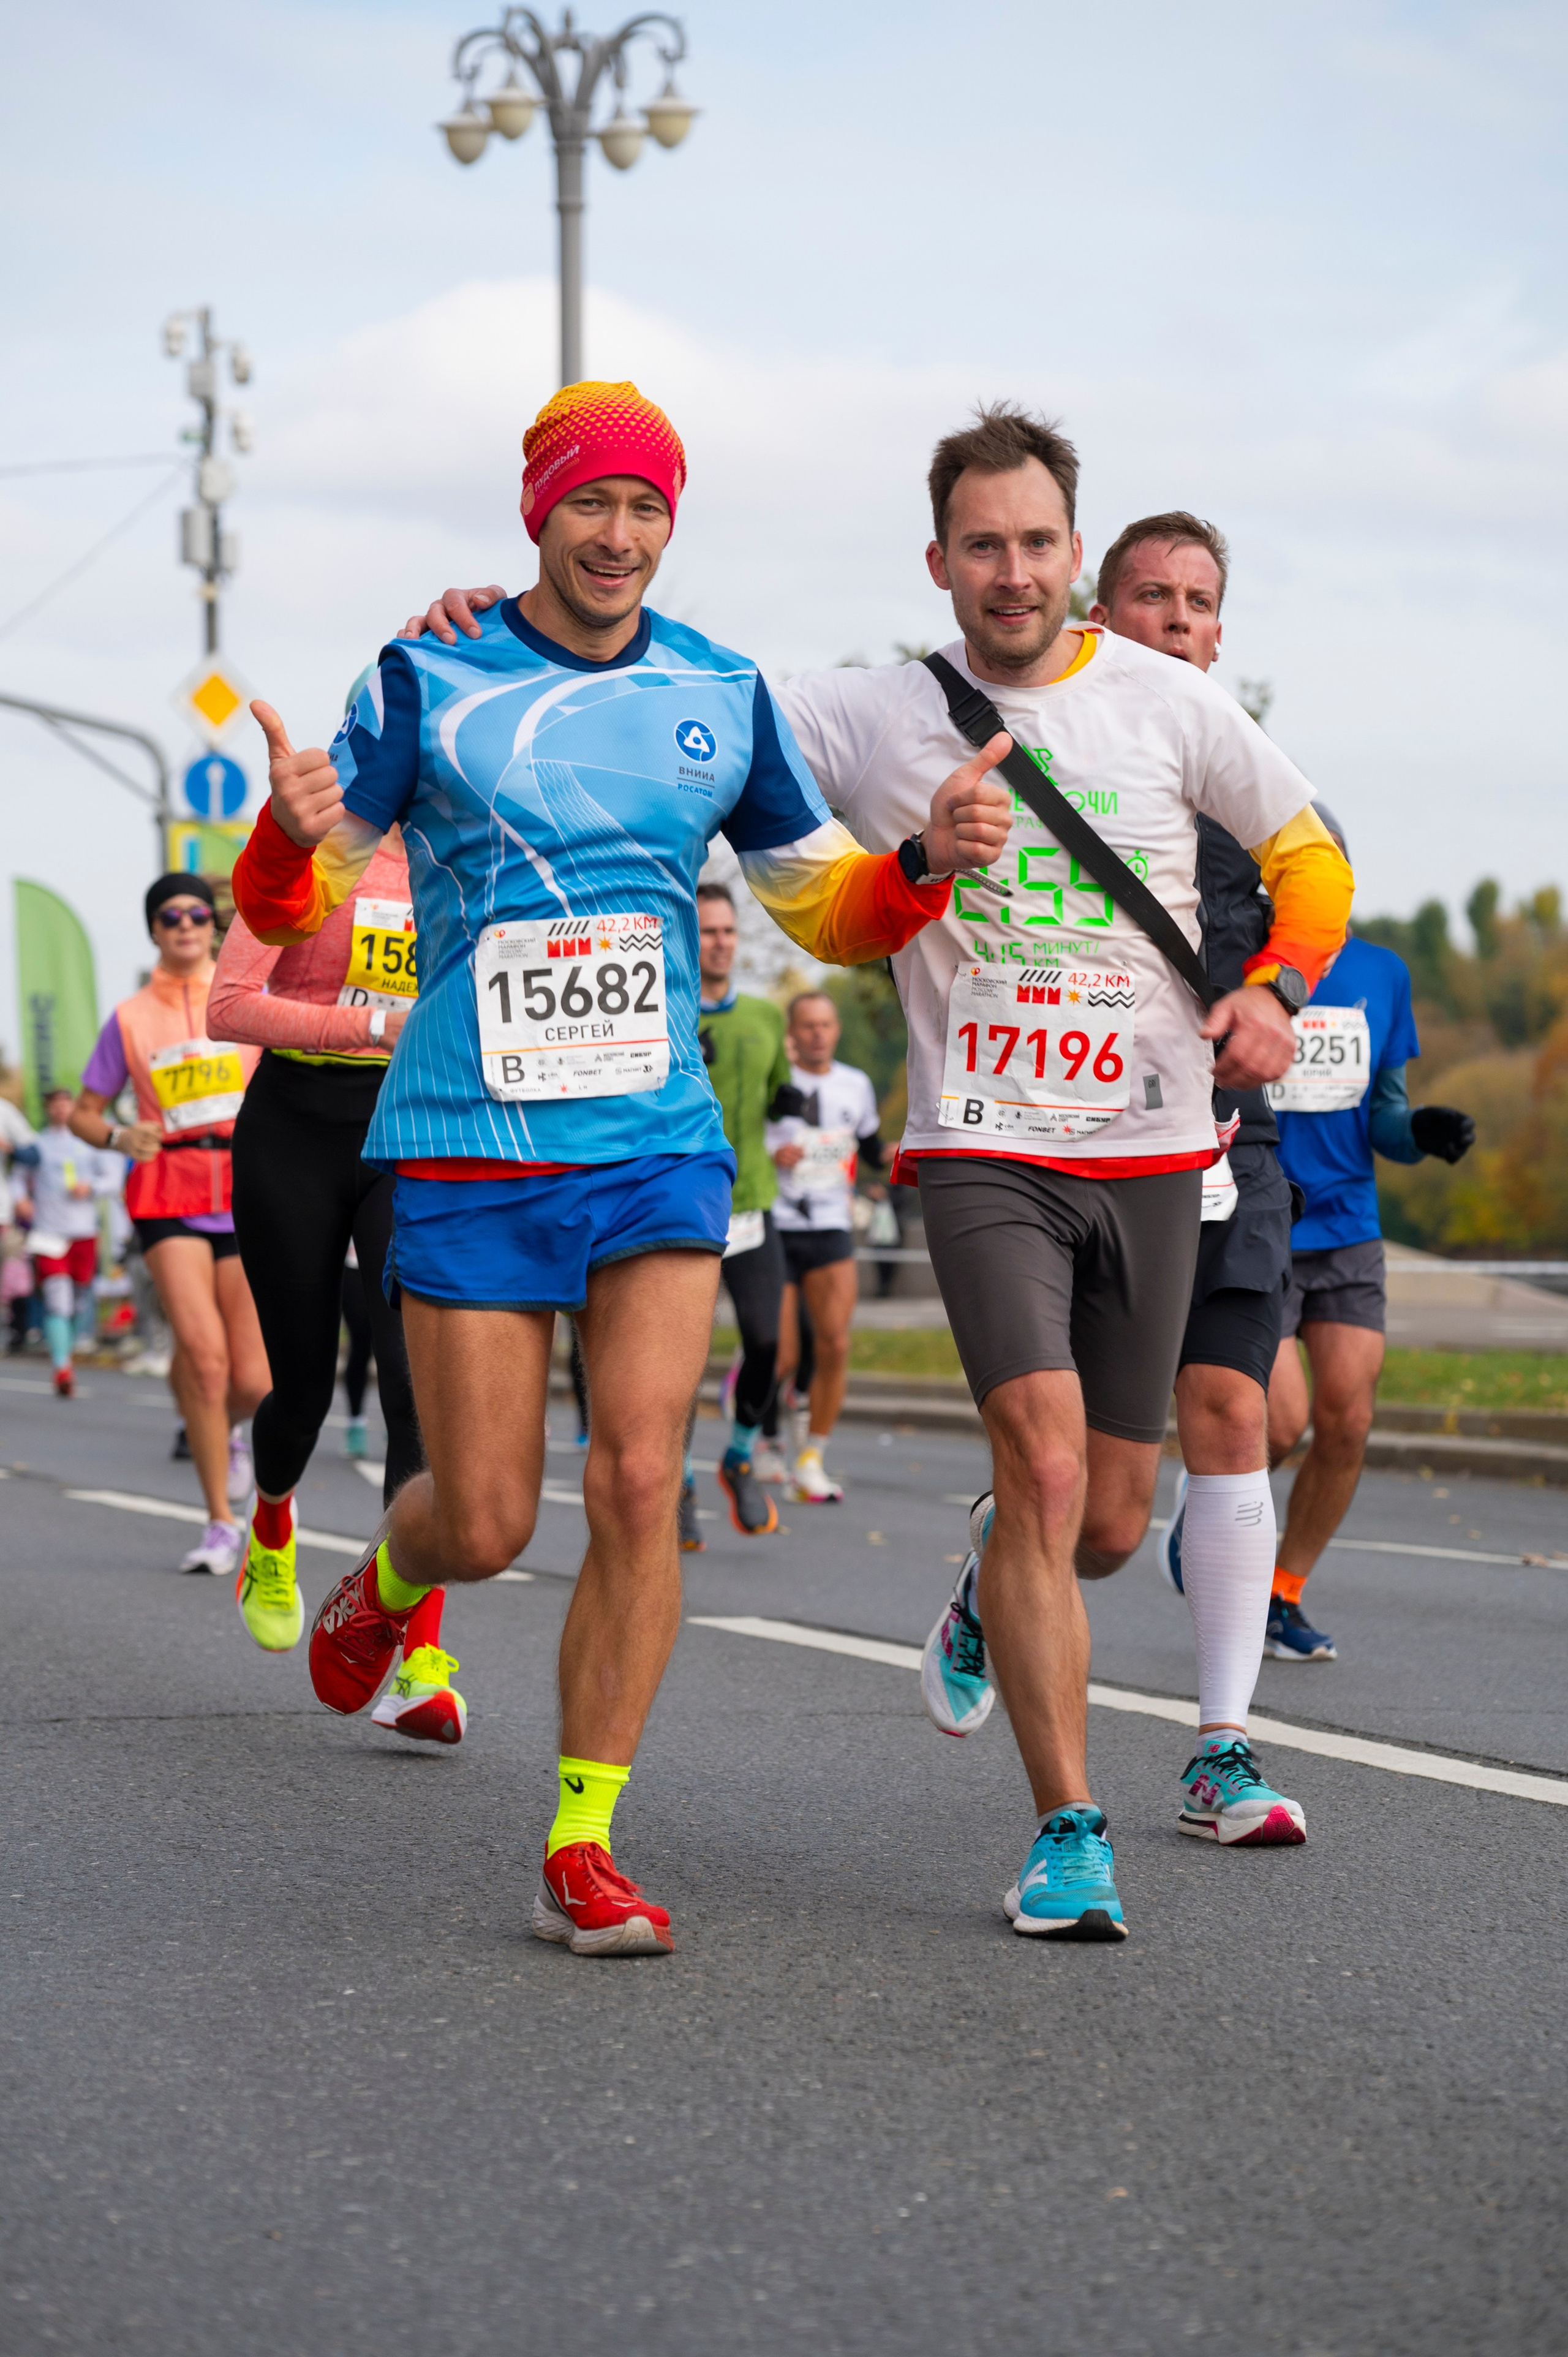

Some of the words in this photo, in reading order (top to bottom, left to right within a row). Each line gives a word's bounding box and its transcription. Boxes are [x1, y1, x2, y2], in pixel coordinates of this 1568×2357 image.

[535, 443, 581, 492] ПУДОВЫЙ
[679, 766, 715, 783] ВНИИА
[677, 783, 713, 798] РОСАТОМ
[1063, 791, 1118, 815] ОЧИ
[597, 918, 630, 933] 42,2
[1068, 972, 1101, 989] 42,2
[350, 989, 369, 1006] D
[488, 960, 659, 1024] 15682
[545, 1019, 614, 1041] СЕРГЕЙ
[958, 1022, 1123, 1083] 17196
[164, 1060, 230, 1092] 7796
[1272, 1084, 1286, 1100] D
